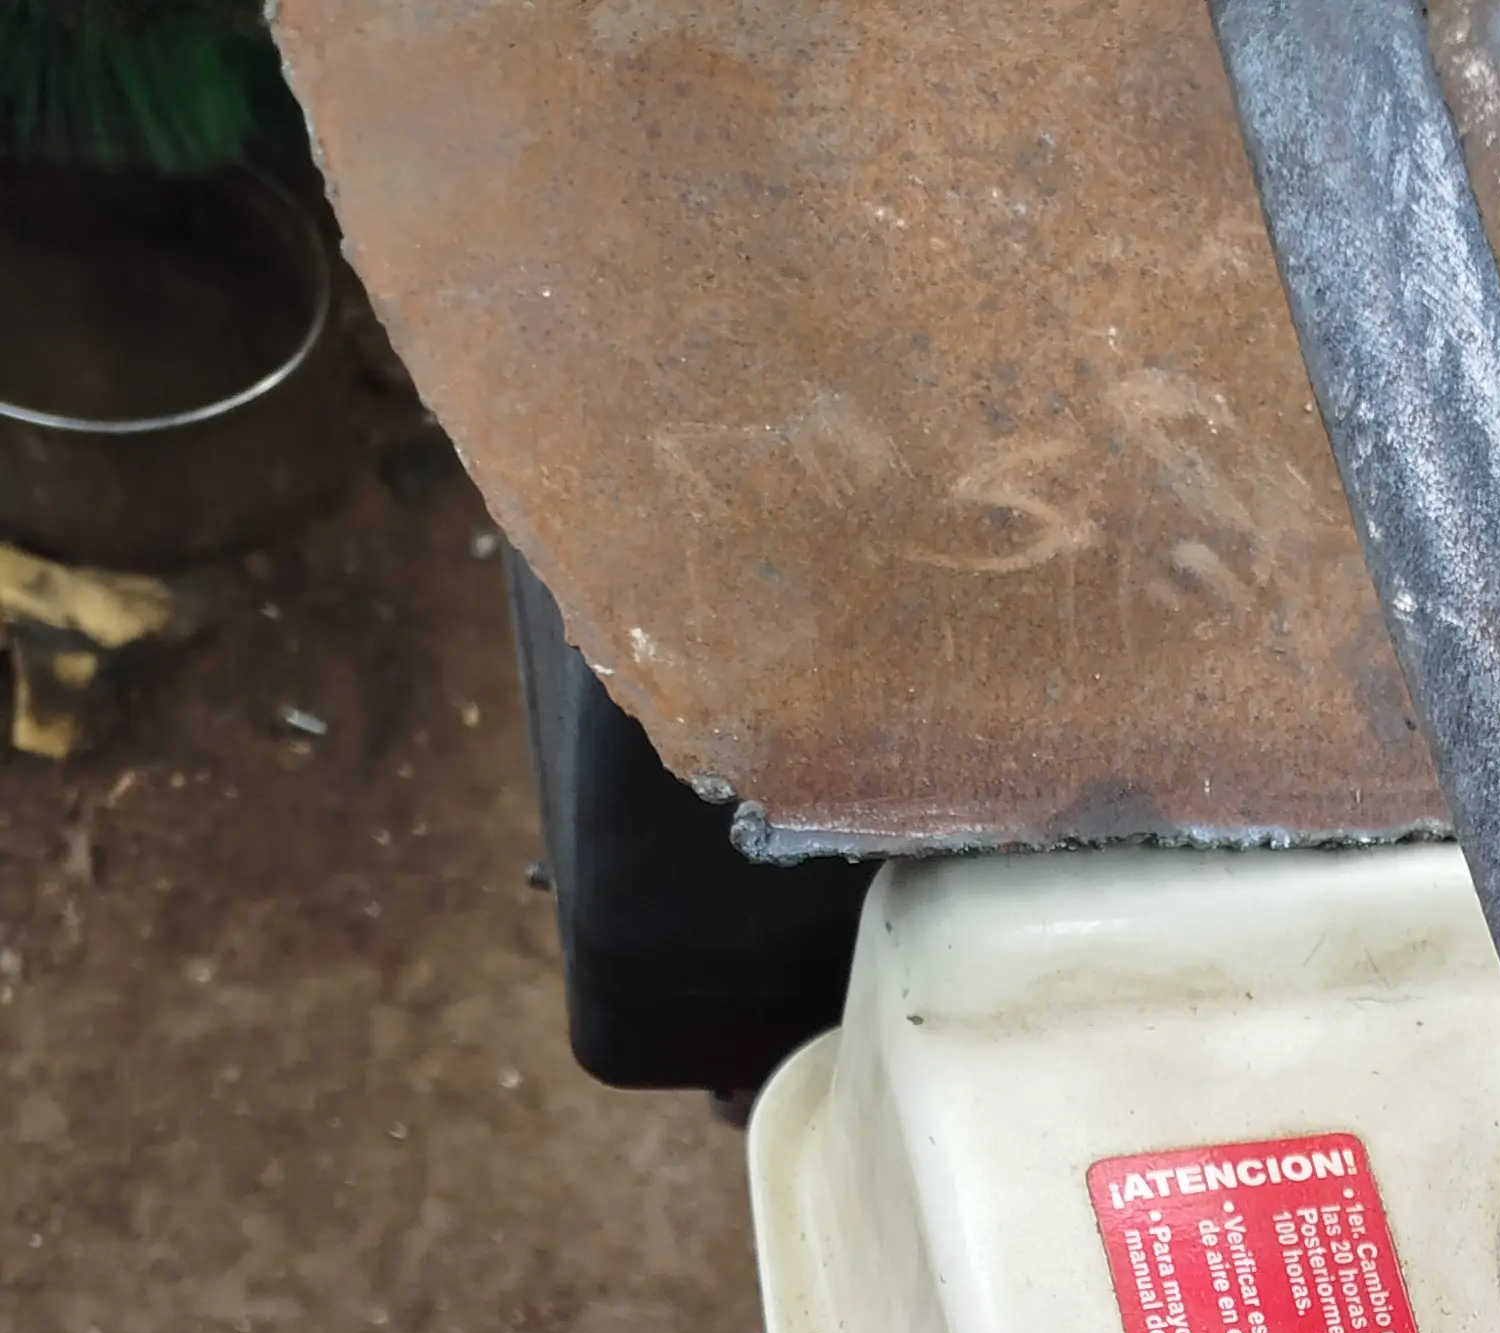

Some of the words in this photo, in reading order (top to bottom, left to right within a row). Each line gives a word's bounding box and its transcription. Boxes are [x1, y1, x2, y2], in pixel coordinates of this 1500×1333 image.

[1109, 1149, 1357, 1210] ¡ATENCION!
[1196, 1218, 1220, 1246] de
[1273, 1212, 1298, 1244] 100
[1321, 1205, 1341, 1236] las
[1122, 1229, 1163, 1309] manual
[1145, 1225, 1174, 1277] Para
[1206, 1251, 1229, 1291] aire
[1222, 1216, 1260, 1306] Verificar
[1331, 1241, 1353, 1263] 20
[1346, 1204, 1365, 1238] 1er.
[1357, 1243, 1393, 1326] Cambio
[1283, 1250, 1311, 1315] horas.
[1339, 1269, 1367, 1329] horas
[1219, 1296, 1238, 1323] en
